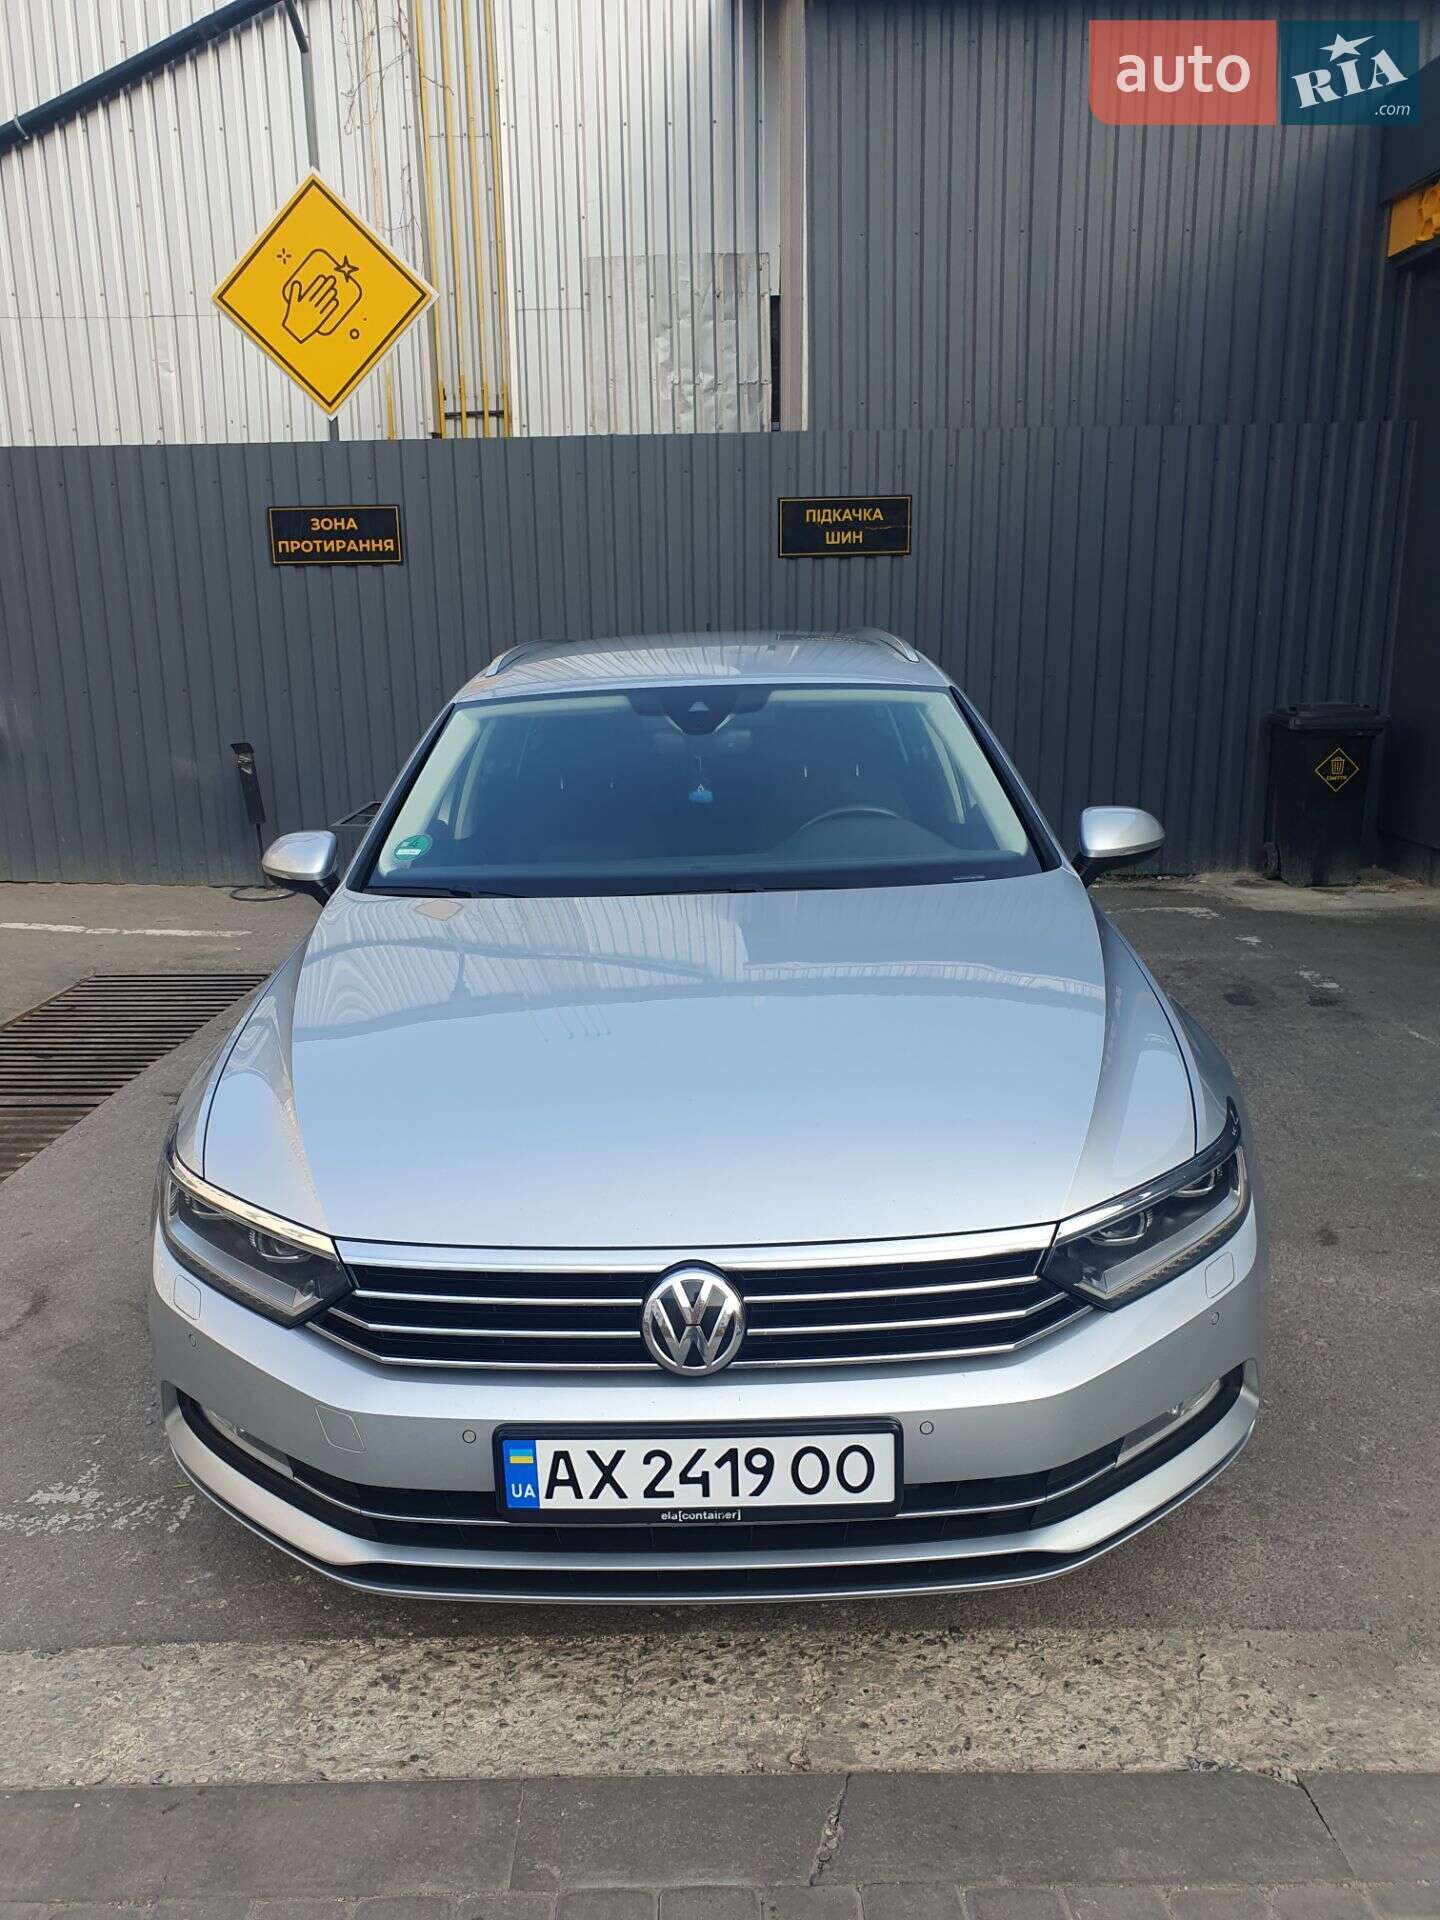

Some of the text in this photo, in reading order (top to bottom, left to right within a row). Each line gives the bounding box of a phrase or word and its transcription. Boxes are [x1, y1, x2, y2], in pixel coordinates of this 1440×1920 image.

[805, 507, 884, 524] ПІДКАЧКА
[310, 517, 358, 531] ЗОНА
[825, 531, 863, 544] ШИН
[278, 539, 394, 553] ПРОТИРАННЯ
[544, 1449, 628, 1500] AX
[642, 1447, 775, 1499] 2419
[511, 1484, 536, 1499] UA
